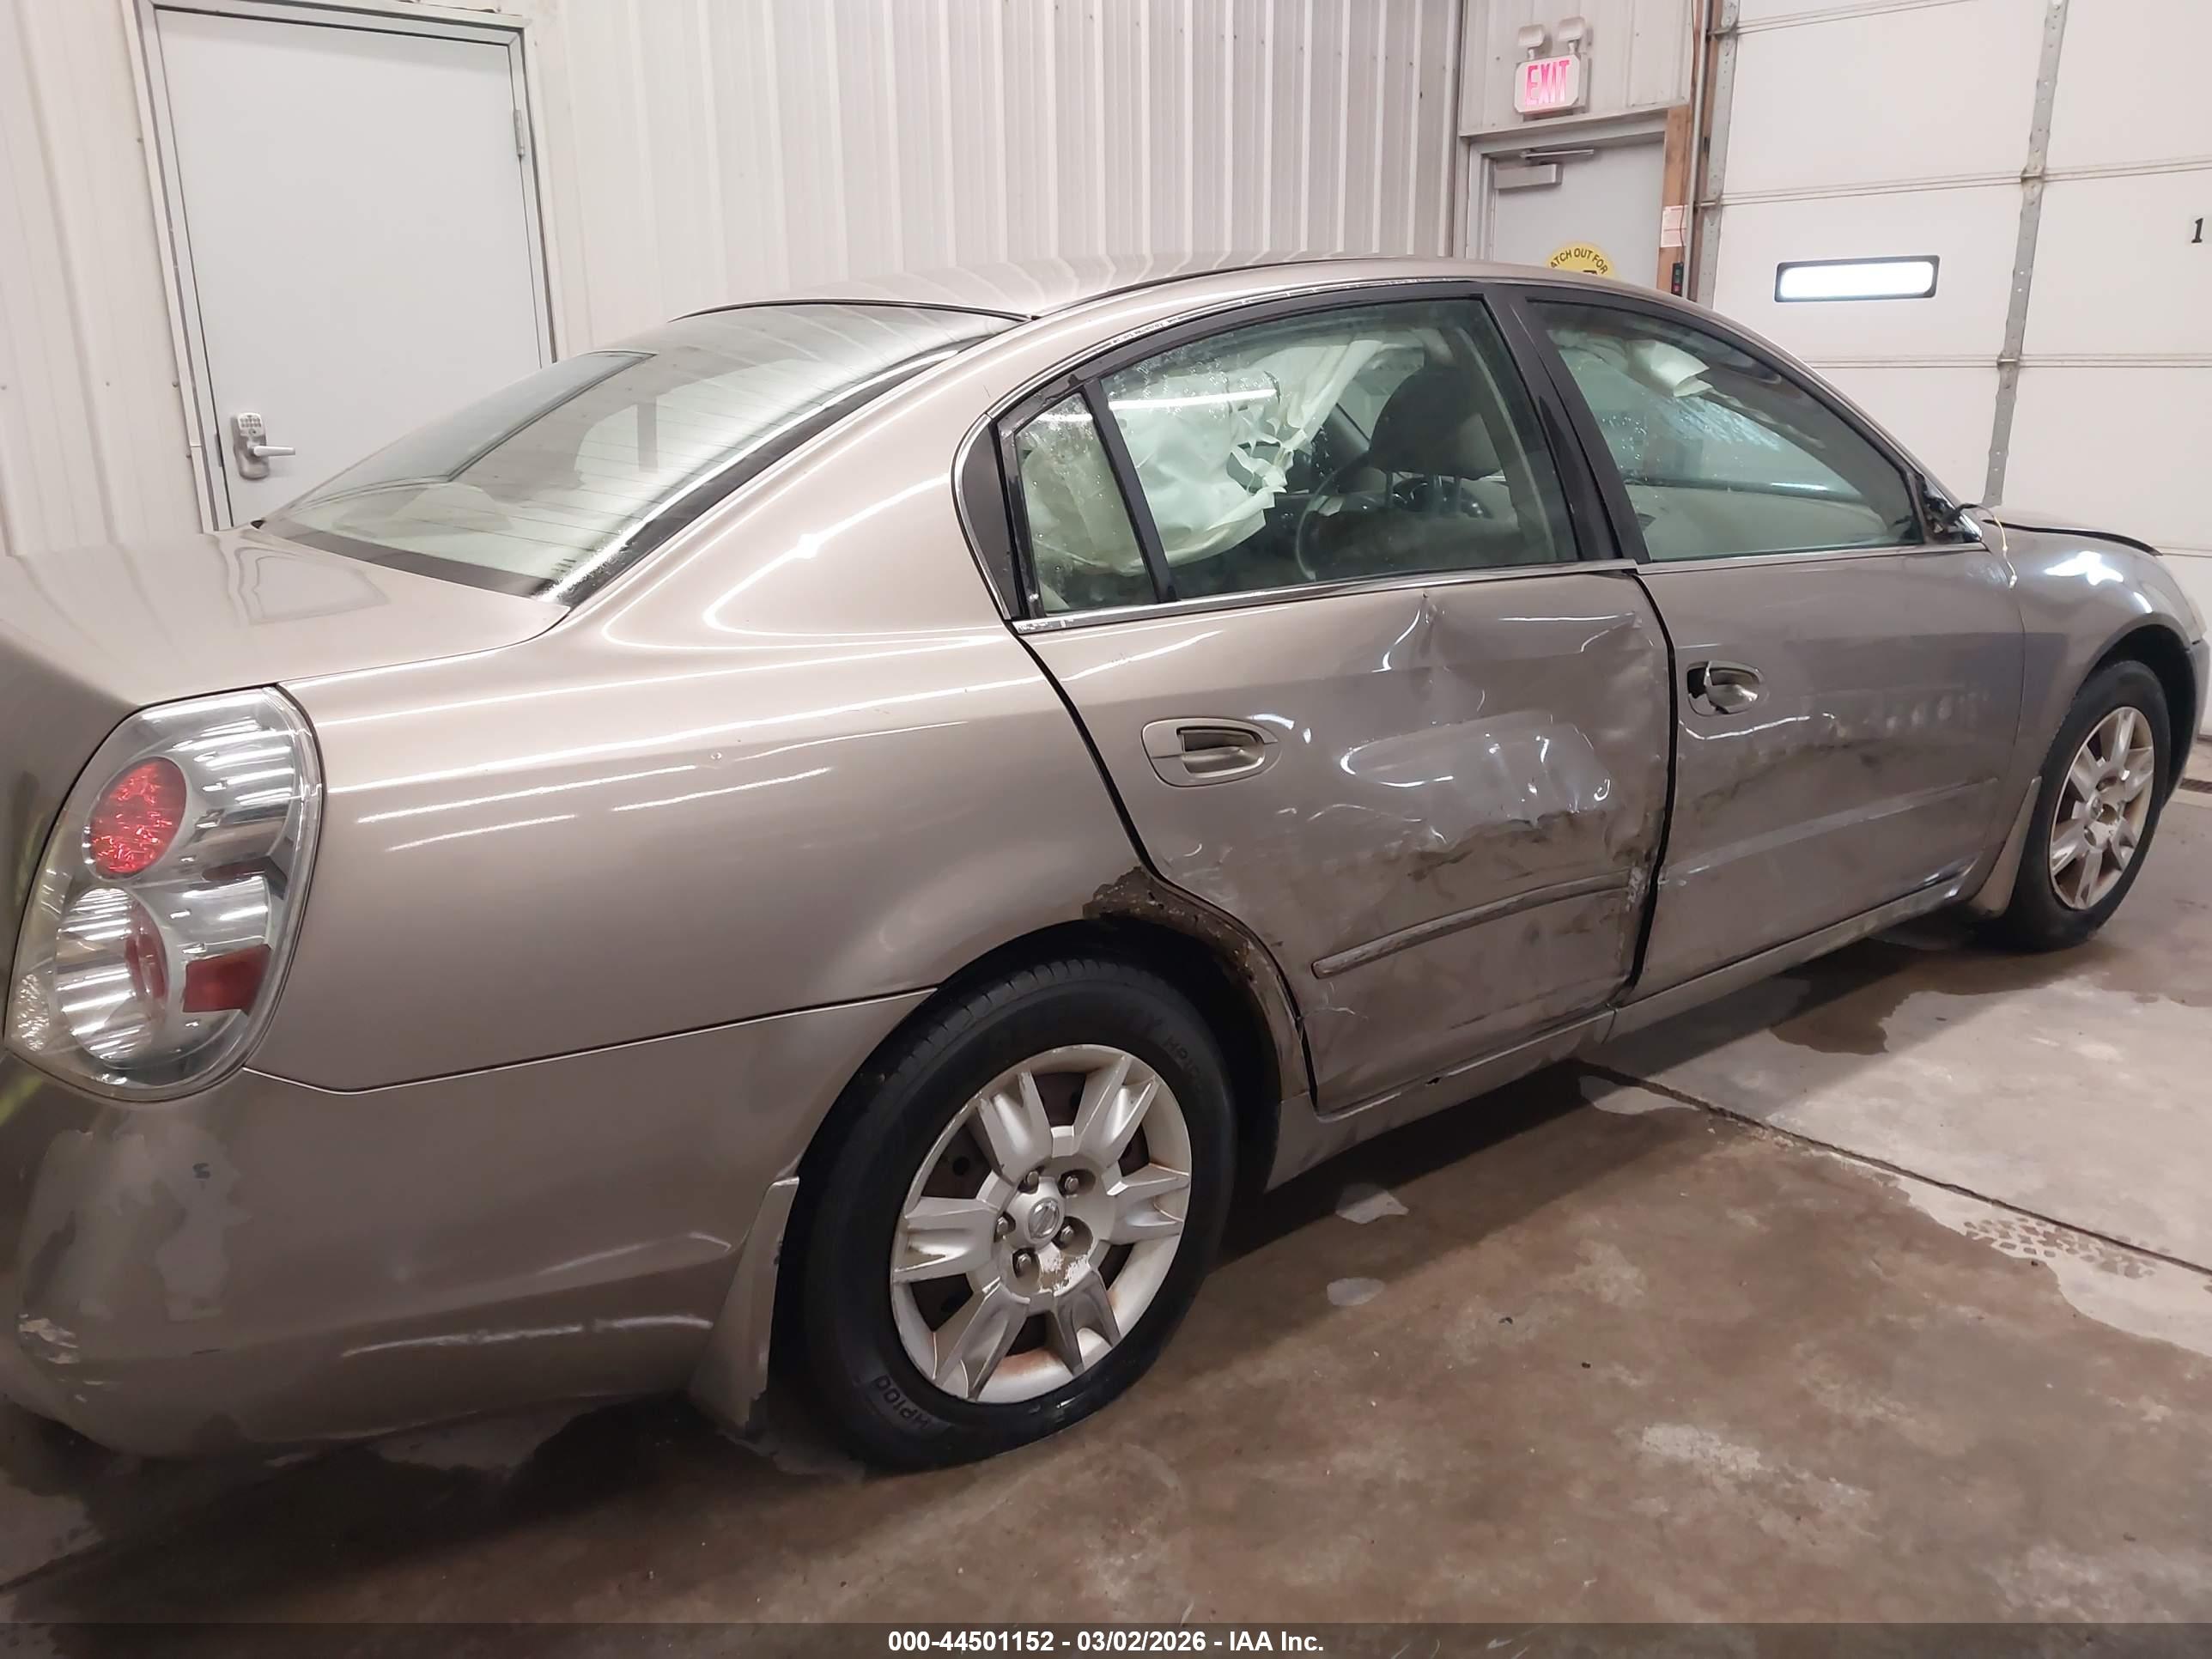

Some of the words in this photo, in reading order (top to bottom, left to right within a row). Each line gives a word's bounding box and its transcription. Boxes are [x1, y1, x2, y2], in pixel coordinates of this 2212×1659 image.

[1526, 59, 1570, 105] EXIT
[2191, 217, 2203, 243] 1
[1550, 248, 1572, 268] ATCH
[1574, 247, 1594, 259] OUT
[1592, 254, 1608, 275] FOR
